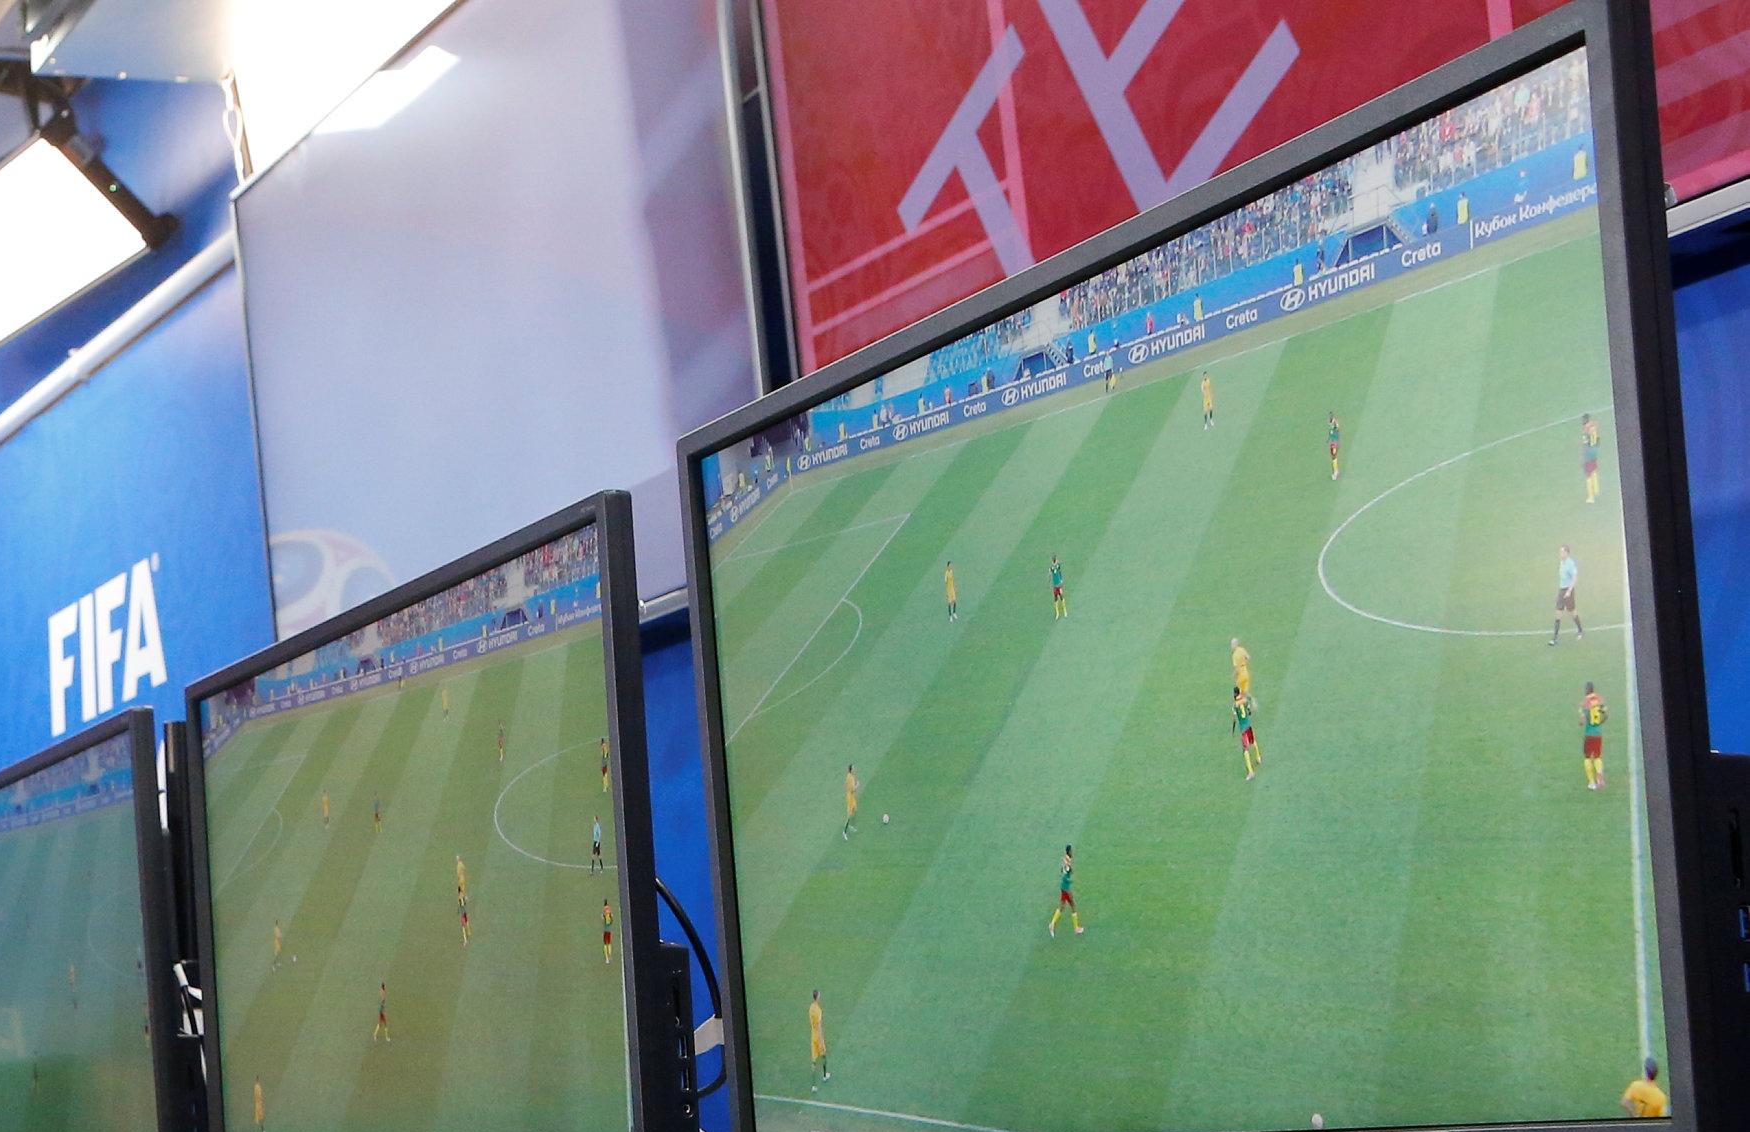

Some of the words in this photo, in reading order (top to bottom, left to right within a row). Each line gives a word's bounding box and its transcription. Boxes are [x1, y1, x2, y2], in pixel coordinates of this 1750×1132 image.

[1474, 213, 1517, 239] Кубок
[909, 411, 949, 436] HYUNDAI
[963, 401, 987, 418] Creta
[1021, 374, 1067, 401] HYUNDAI
[1150, 325, 1206, 356] HYUNDAI
[1225, 308, 1258, 330] Creta
[1308, 263, 1375, 301] HYUNDAI
[1401, 241, 1442, 268] Creta
[48, 557, 168, 738] FIFA
